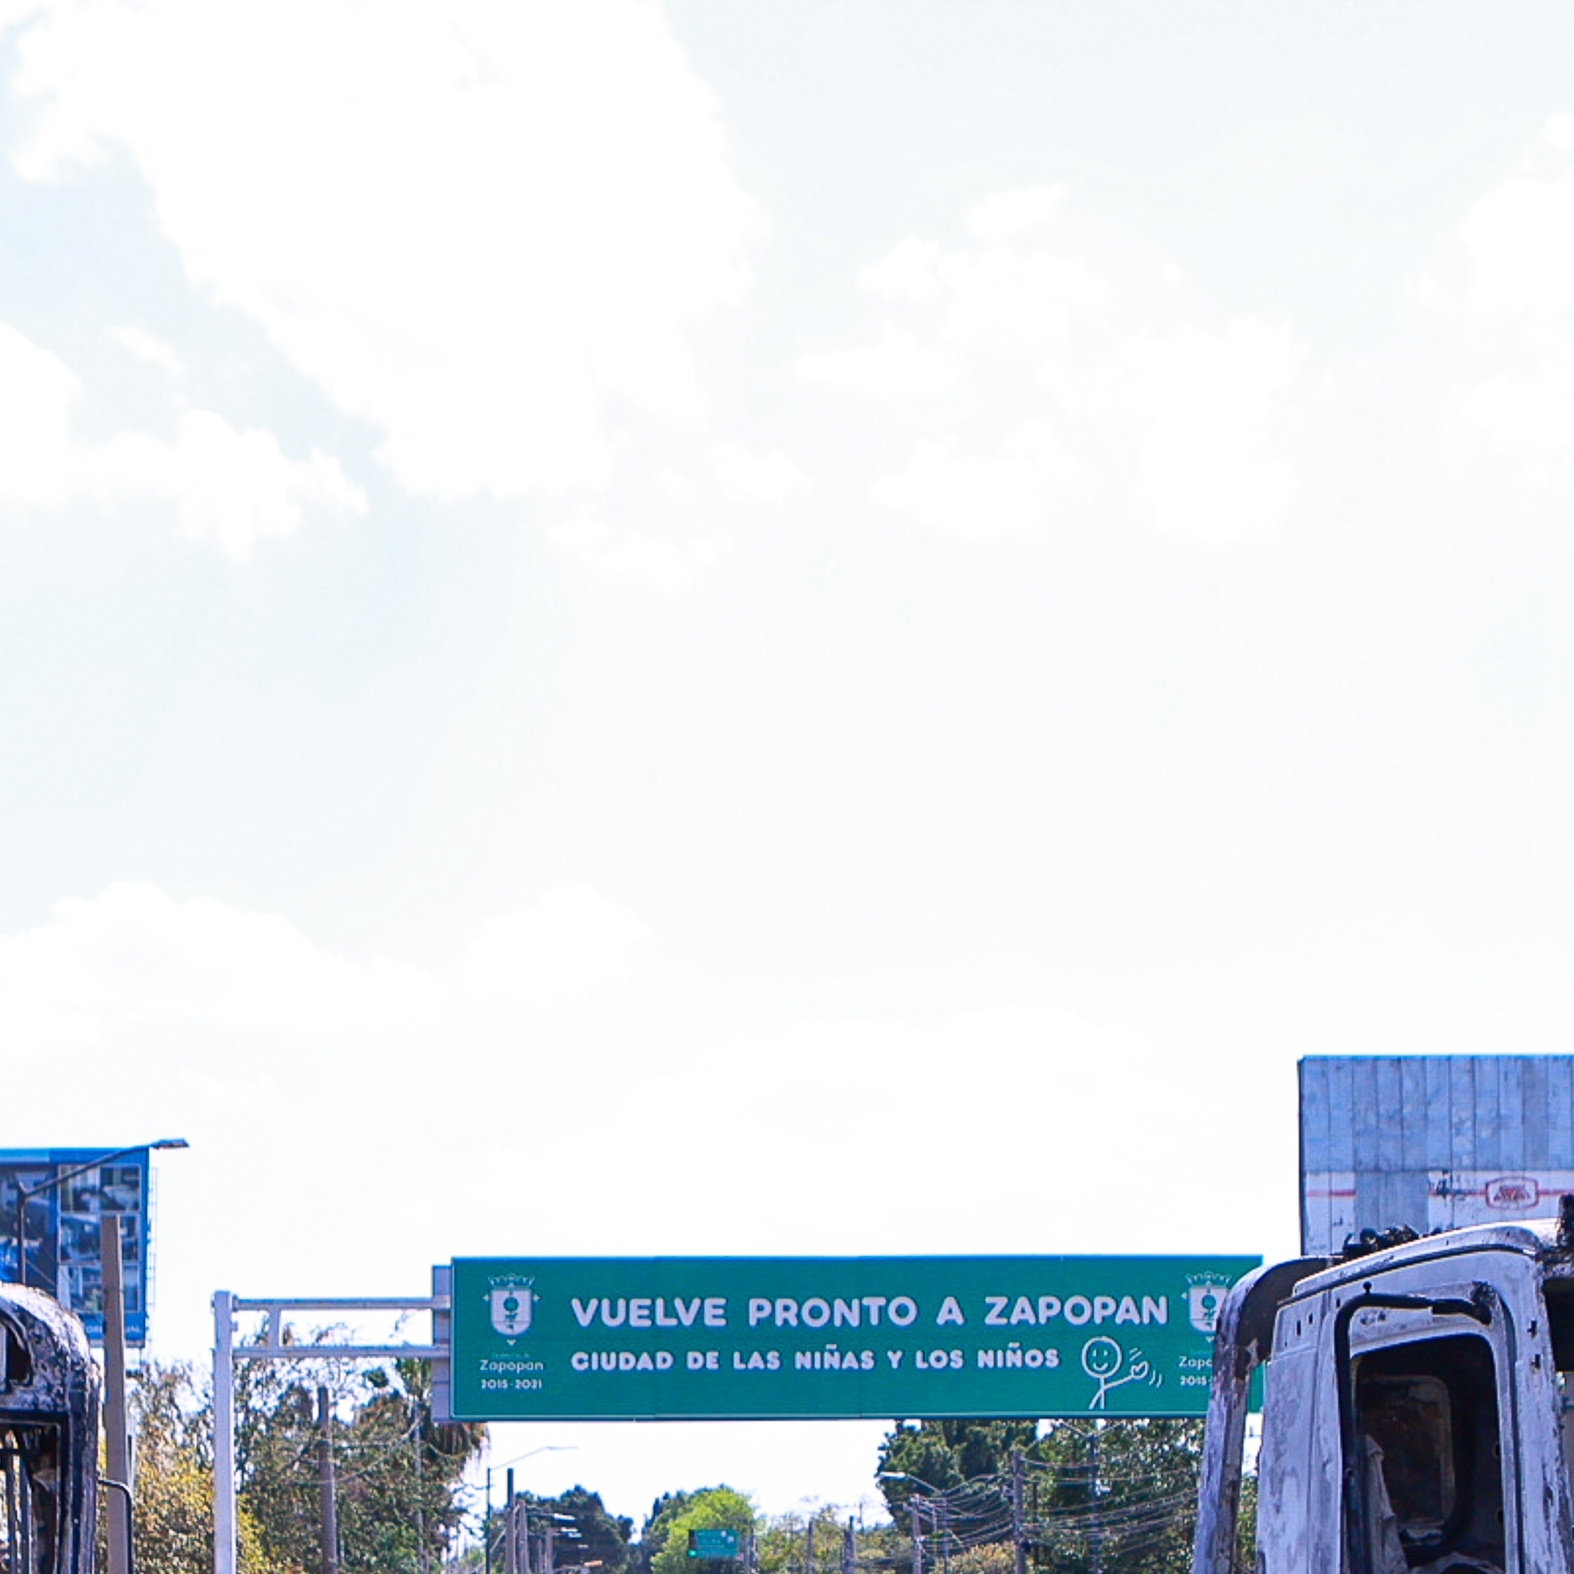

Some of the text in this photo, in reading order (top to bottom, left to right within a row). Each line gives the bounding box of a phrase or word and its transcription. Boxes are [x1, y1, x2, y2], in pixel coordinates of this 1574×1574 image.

[570, 1295, 1169, 1328] VUELVE PRONTO A ZAPOPAN
[479, 1359, 544, 1374] Zapopan
[570, 1342, 1060, 1371] CIUDAD DE LAS NIÑAS Y LOS NIÑOS
[1178, 1356, 1212, 1371] Zapo
